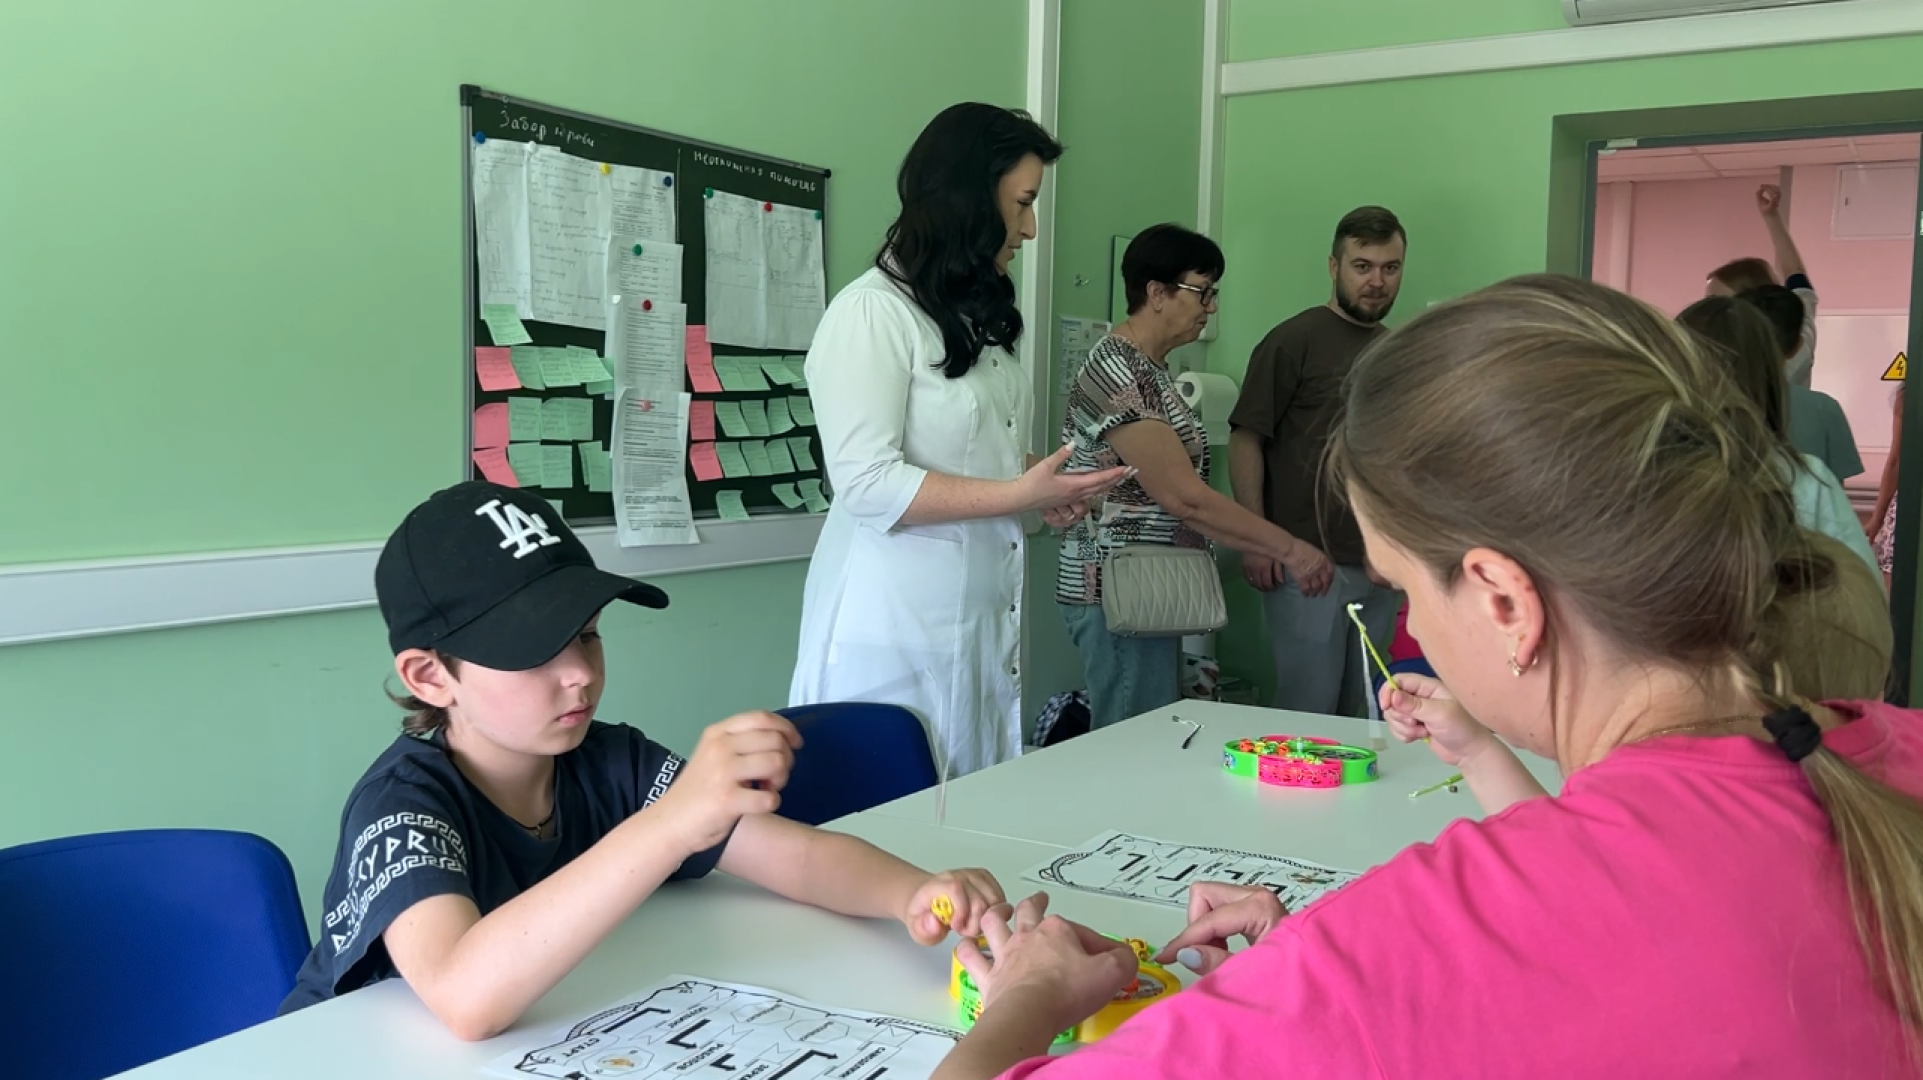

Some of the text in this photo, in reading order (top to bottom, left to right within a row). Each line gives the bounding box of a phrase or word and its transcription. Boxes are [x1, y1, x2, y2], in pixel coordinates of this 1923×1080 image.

[499, 110, 547, 141] Забор
[475, 498, 561, 559] LA
[357, 829, 459, 882] CYPRU
